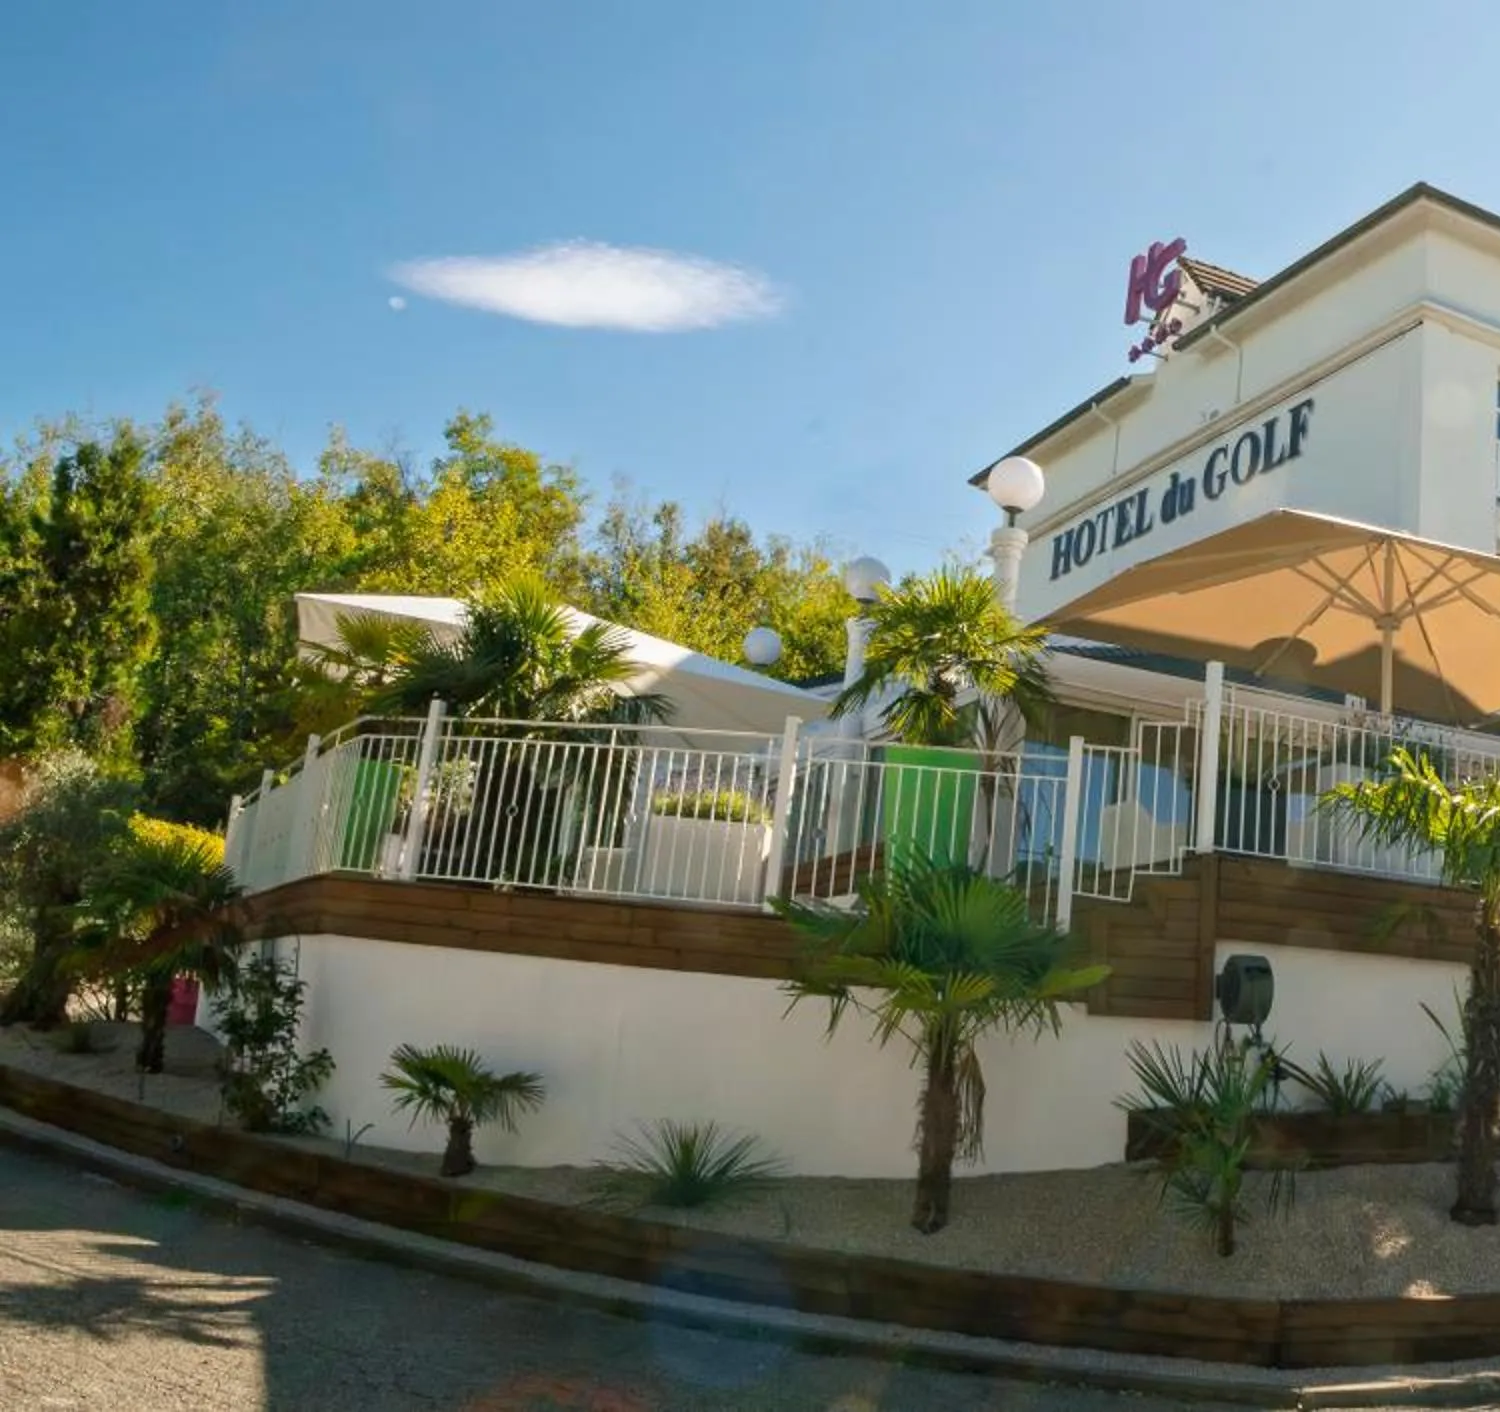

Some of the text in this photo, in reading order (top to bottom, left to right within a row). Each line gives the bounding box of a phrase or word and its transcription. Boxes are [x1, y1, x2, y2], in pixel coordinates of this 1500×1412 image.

[1124, 237, 1187, 324] HG
[1049, 398, 1314, 581] HOTEL du GOLF
